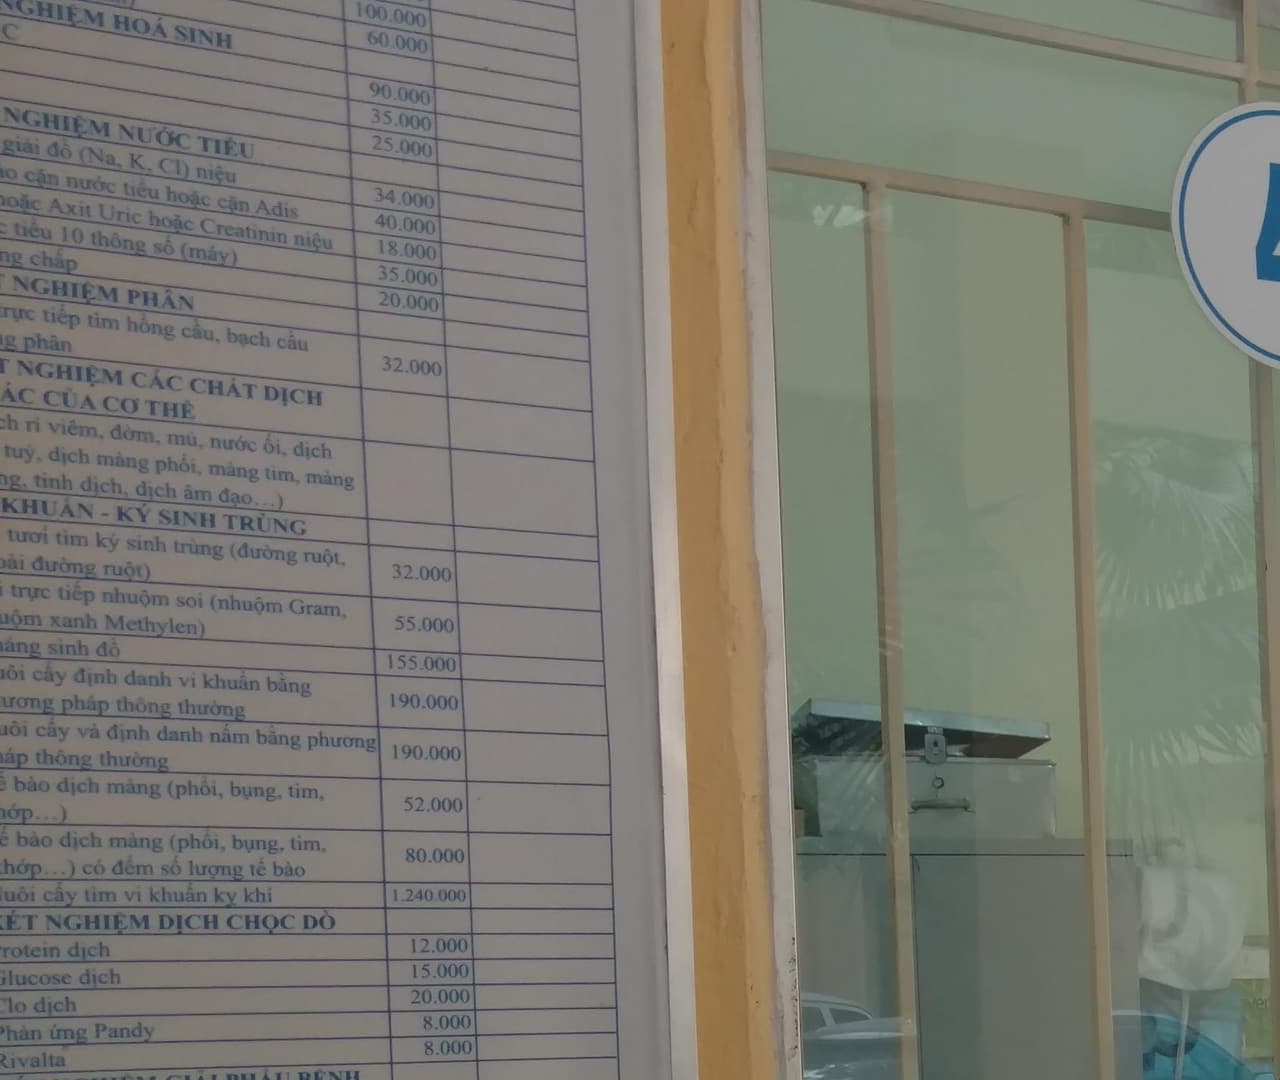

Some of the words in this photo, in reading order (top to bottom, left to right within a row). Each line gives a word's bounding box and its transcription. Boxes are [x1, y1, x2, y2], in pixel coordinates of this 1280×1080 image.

[113, 14, 169, 39] HOÁ
[173, 24, 233, 50] SINH
[367, 30, 429, 54] 60.000
[368, 81, 431, 105] 90.000
[3, 106, 110, 138] NGHIỆM
[371, 107, 432, 131] 35.000
[372, 134, 433, 159] 25.000
[375, 186, 436, 209] 34.000
[374, 213, 436, 235] 40.000
[379, 239, 437, 260] 18.000
[378, 264, 438, 287] 35.000
[12, 275, 119, 303] NGHIỆM
[127, 288, 194, 311] PHÂN
[378, 290, 440, 313] 20.000
[381, 355, 443, 377] 32.000
[17, 359, 123, 387] NGHIỆM
[263, 384, 323, 407] DỊCH
[116, 502, 147, 524] KÝ
[158, 509, 216, 529] SINH
[222, 512, 307, 536] TRÙNG
[391, 563, 453, 583] 32.000
[394, 615, 455, 634] 55.000
[387, 653, 457, 673] 155.000
[389, 692, 459, 711] 190.000
[392, 743, 462, 762] 190.000
[403, 796, 464, 814] 52.000
[404, 847, 465, 864] 80.000
[392, 888, 467, 903] 1.240.000
[45, 913, 151, 933] NGHIỆM
[158, 914, 220, 933] DỊCH
[225, 913, 296, 933] CHỌC
[410, 937, 469, 954] 12.000
[412, 962, 470, 979] 15.000
[410, 988, 471, 1005] 20.000
[423, 1014, 472, 1031] 8.000
[423, 1039, 473, 1057] 8.000
